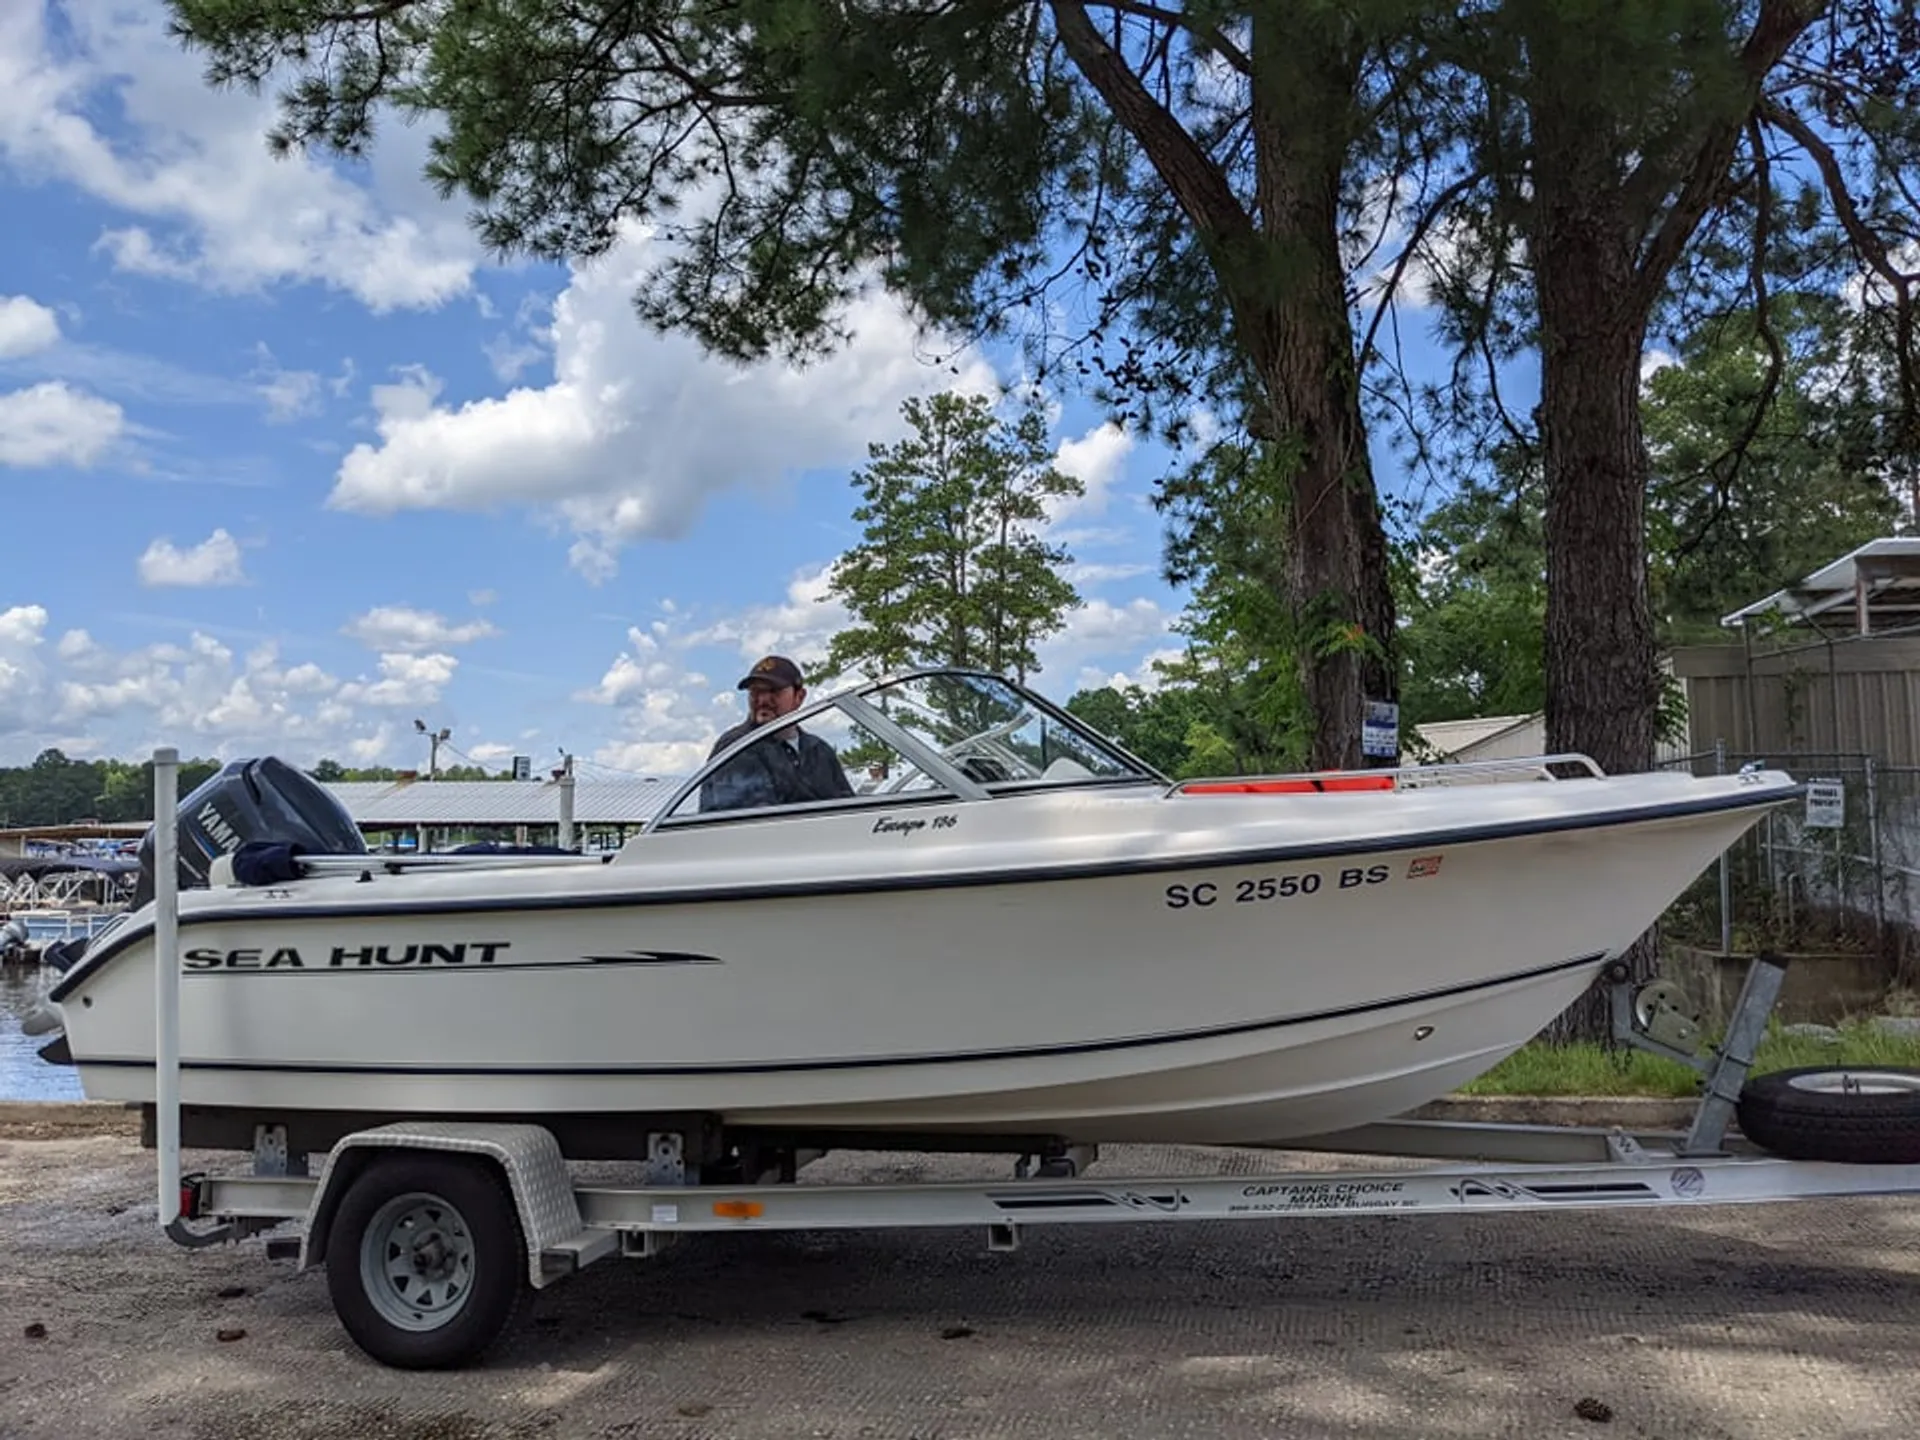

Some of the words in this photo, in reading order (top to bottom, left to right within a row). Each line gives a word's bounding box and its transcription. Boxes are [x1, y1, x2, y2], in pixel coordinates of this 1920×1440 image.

[197, 801, 243, 855] YAMA
[1165, 884, 1217, 909] SC
[1235, 874, 1321, 903] 2550
[1338, 865, 1390, 889] BS
[183, 947, 304, 970] SEA
[328, 942, 511, 967] HUNT
[1242, 1184, 1331, 1197] CAPTAINS
[1336, 1182, 1405, 1194] CHOICE
[1290, 1194, 1358, 1203] MARINE
